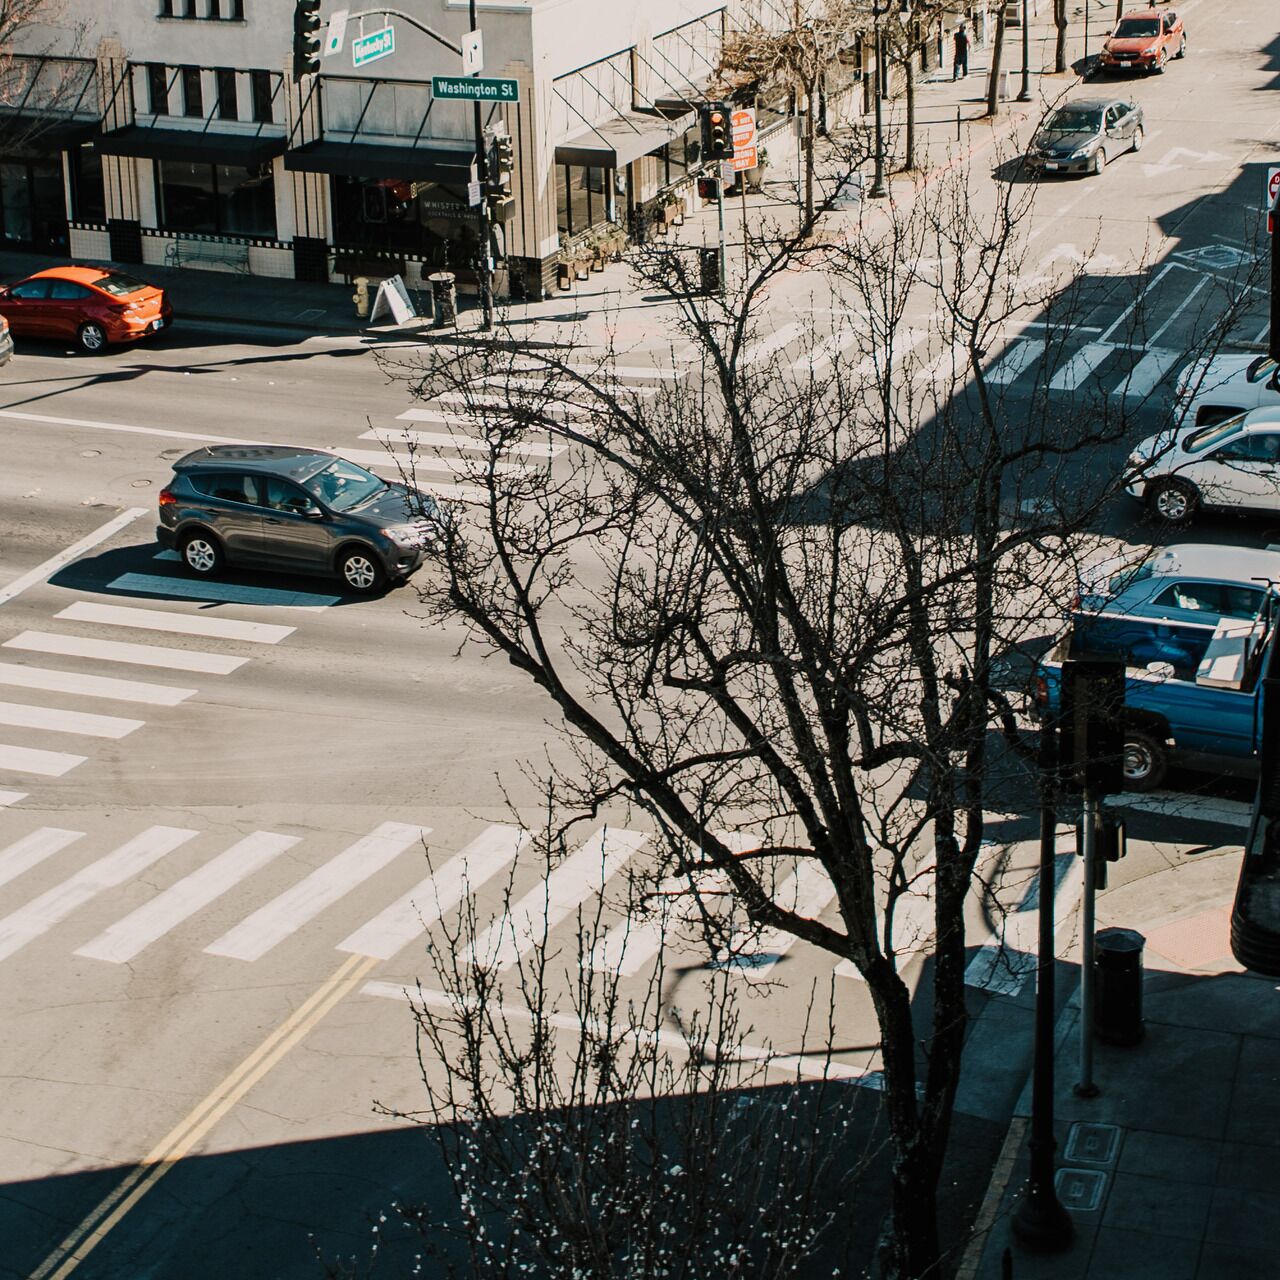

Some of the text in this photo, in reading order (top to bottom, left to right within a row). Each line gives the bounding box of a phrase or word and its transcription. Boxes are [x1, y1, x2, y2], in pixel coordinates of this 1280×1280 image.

[438, 81, 513, 98] Washington St
[735, 158, 750, 168] WAY
